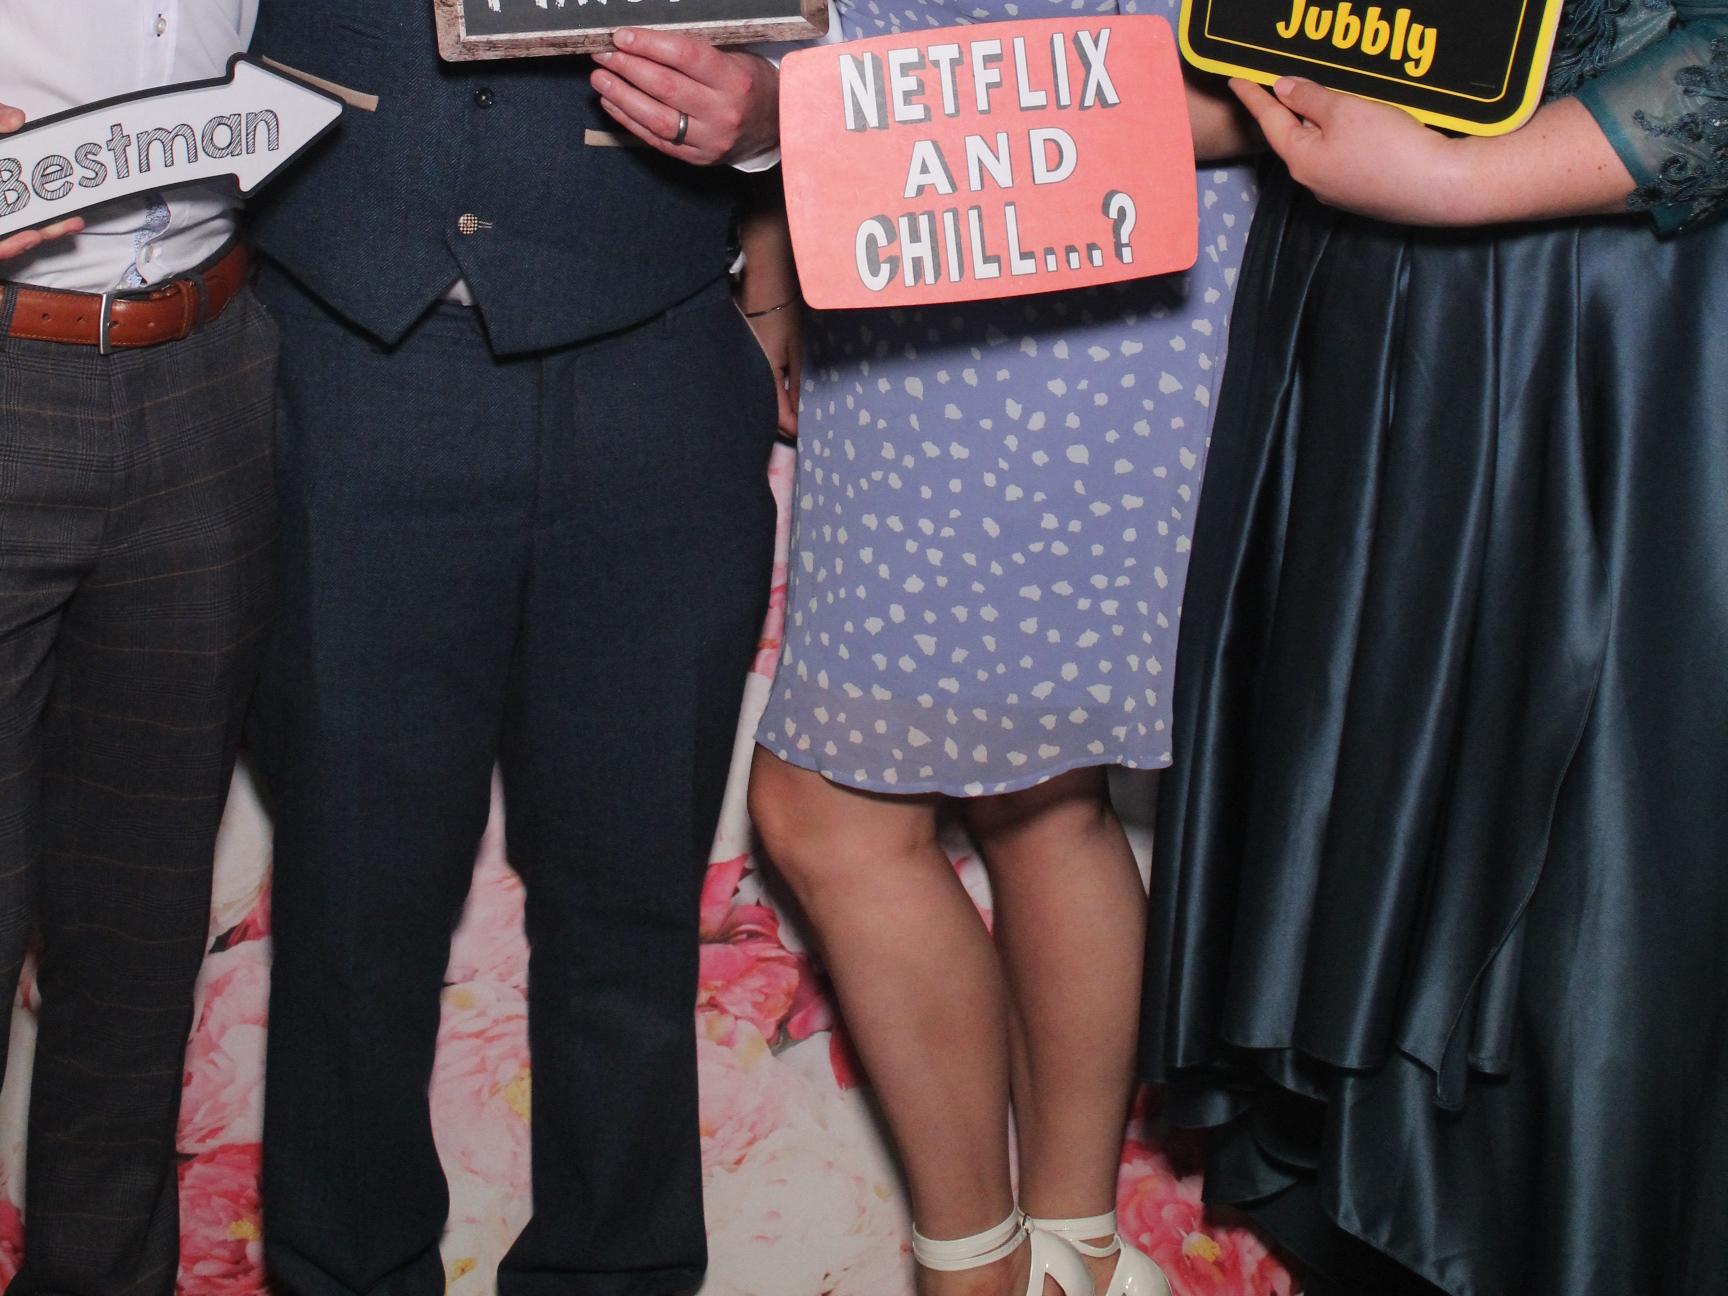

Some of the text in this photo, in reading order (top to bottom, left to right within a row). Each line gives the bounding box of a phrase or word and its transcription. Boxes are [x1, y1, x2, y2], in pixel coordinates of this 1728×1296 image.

[839, 28, 1120, 132] NETFLIX
[0, 109, 280, 217] Bestman
[904, 128, 1078, 198] AND
